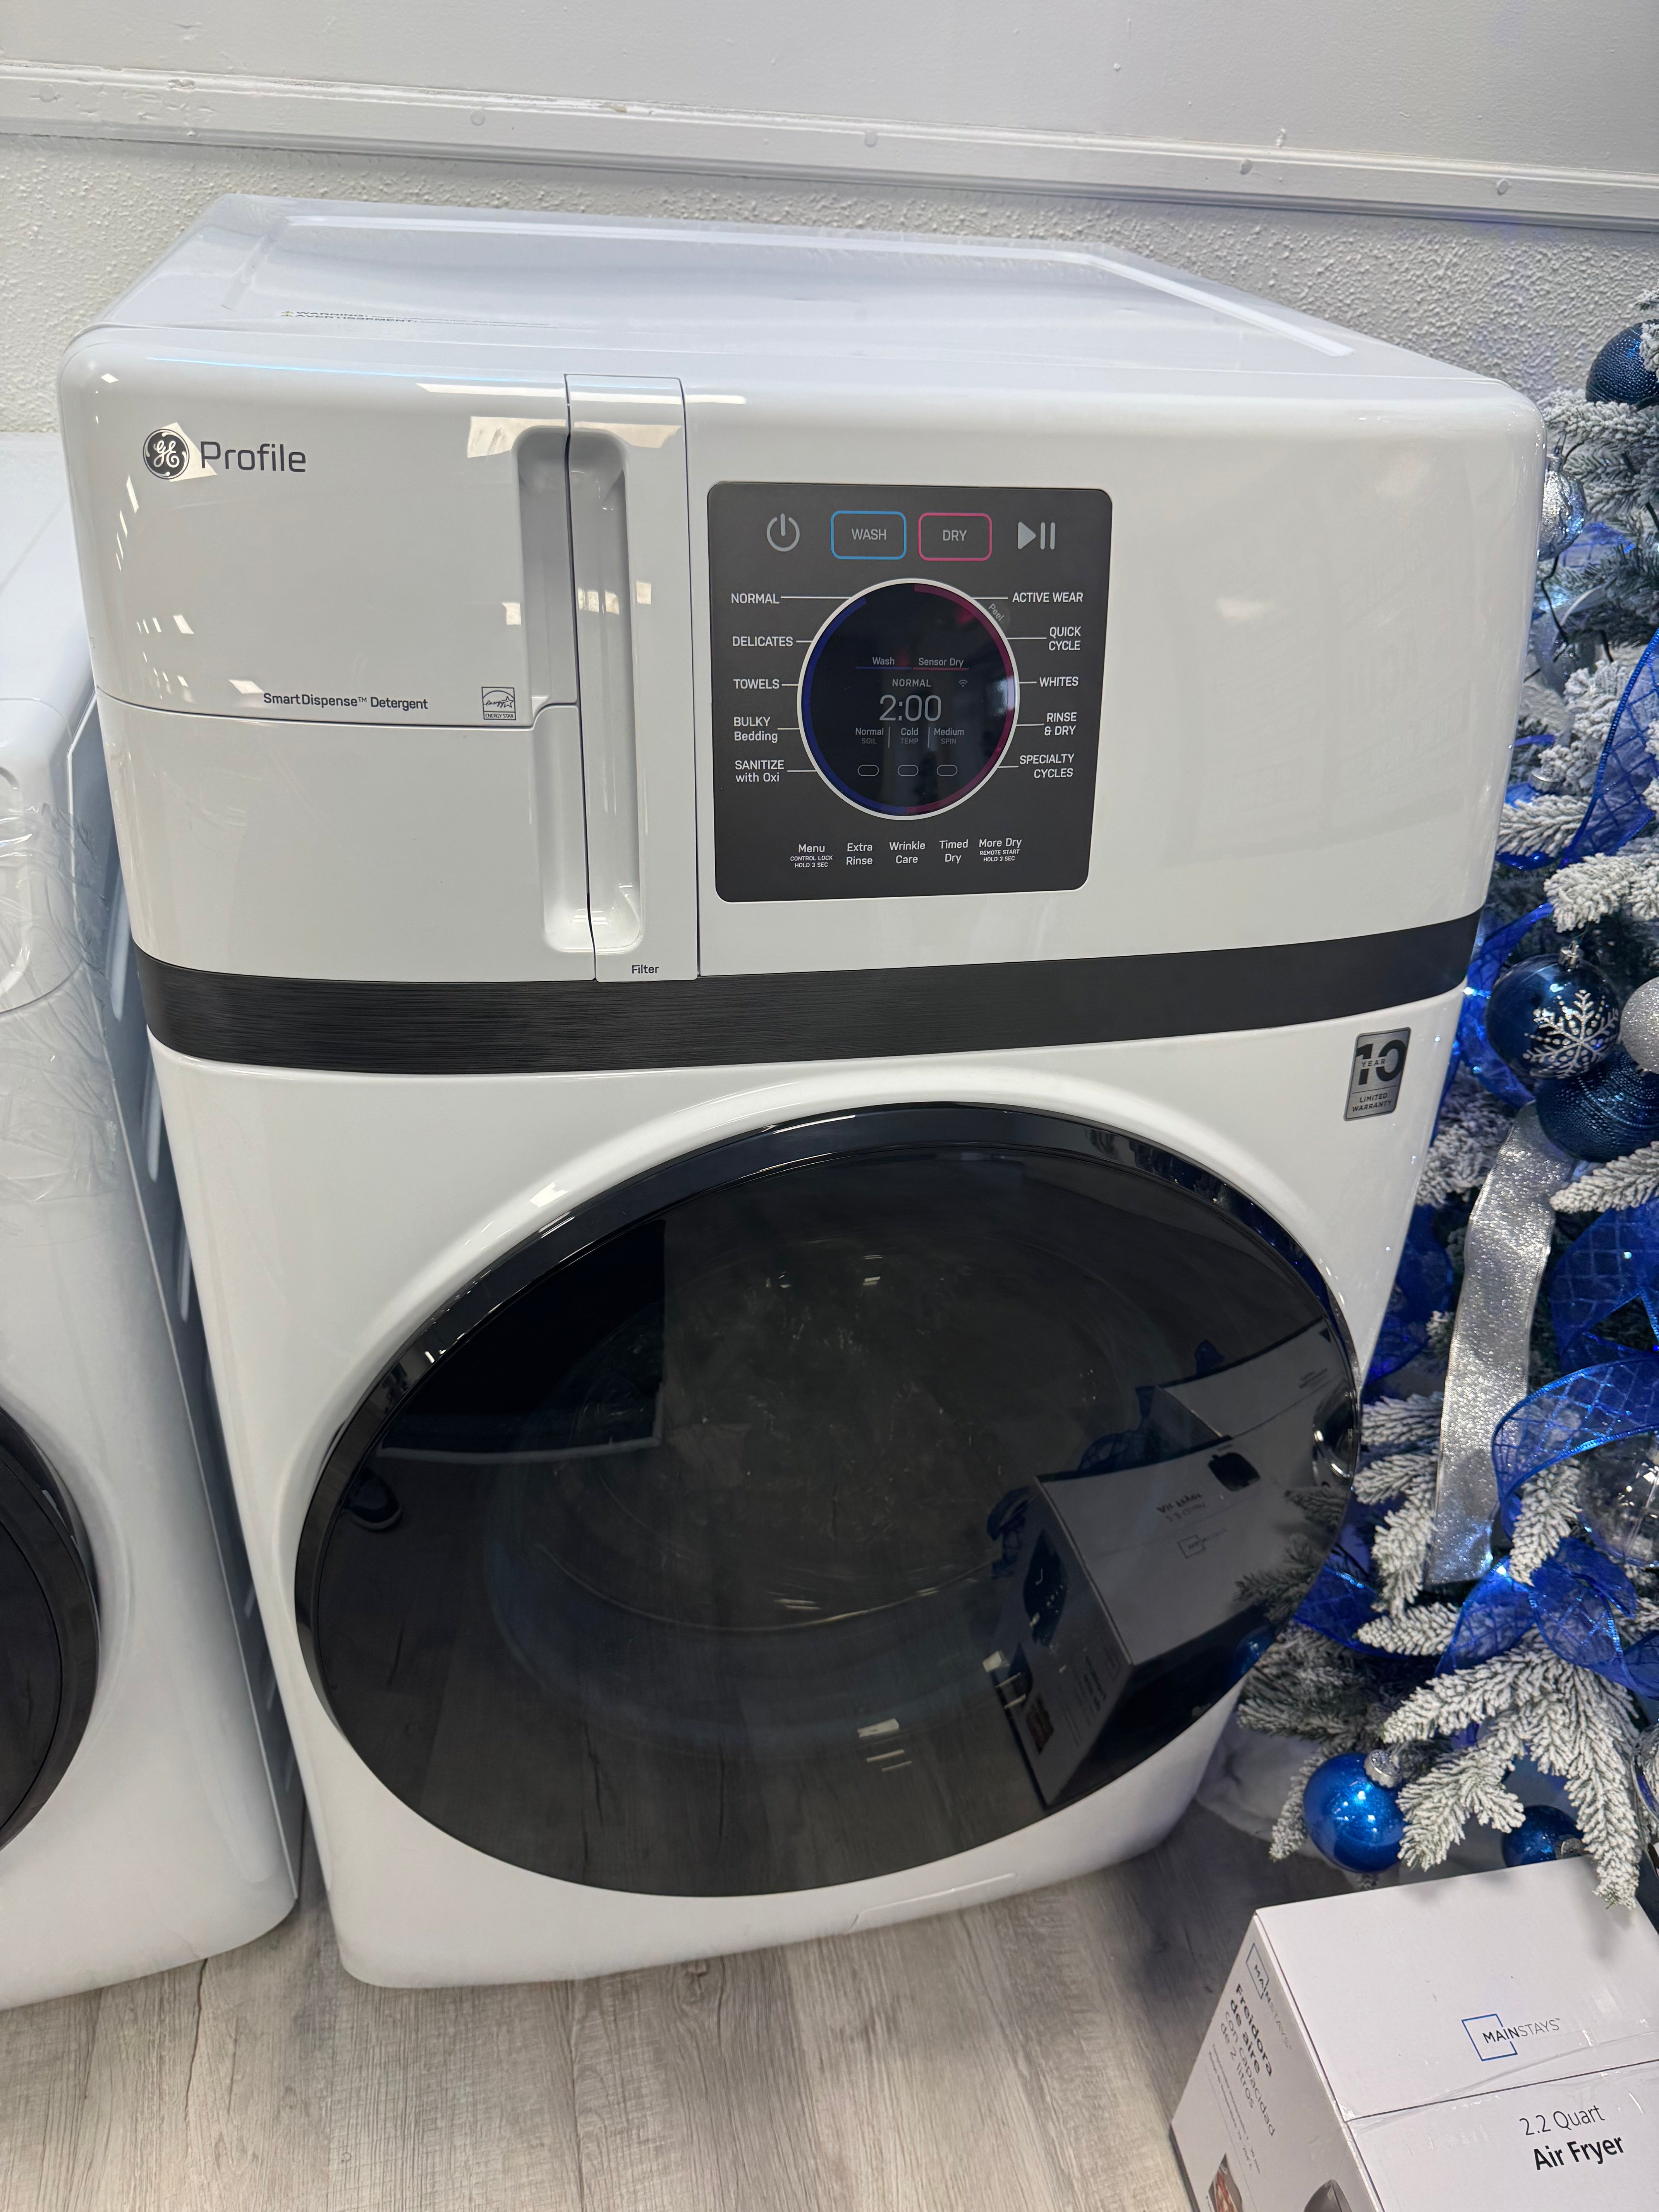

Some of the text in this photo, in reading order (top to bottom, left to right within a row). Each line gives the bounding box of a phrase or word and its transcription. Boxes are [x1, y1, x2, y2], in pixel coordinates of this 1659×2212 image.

[200, 441, 306, 472] Profile
[852, 528, 886, 540] WASH
[943, 530, 967, 541] DRY
[731, 593, 780, 604] NORMAL
[1012, 592, 1083, 603] ACTIVE WEAR
[988, 603, 1005, 622] Peel
[1049, 626, 1082, 638] QUICK
[732, 636, 793, 647] DELICATES
[1049, 640, 1081, 651] CYCLE
[872, 656, 895, 665] Wash
[919, 658, 964, 668] Sensor Dry
[733, 678, 780, 689] TOWELS
[892, 678, 931, 687] NORMAL
[1039, 676, 1079, 687] WHITES
[370, 697, 428, 711] Detergent
[879, 694, 941, 721] 2:00
[734, 716, 771, 726] BULKY
[1047, 712, 1077, 723] RINSE
[855, 727, 884, 735] Normal
[901, 727, 919, 736] Cold
[1044, 725, 1076, 736] & DRY
[734, 731, 778, 743] Bedding
[735, 760, 784, 770] SANITIZE
[1019, 754, 1075, 765] SPECIALTY
[735, 772, 779, 782] with Oxi
[1034, 768, 1073, 778] CYCLES
[798, 844, 825, 853] Menu
[847, 843, 872, 852] Extra
[889, 840, 926, 850] Wrinkle
[939, 839, 968, 849] Timed
[979, 838, 1022, 848] More Dry
[846, 856, 873, 865] Rinse
[896, 855, 918, 864] Care
[945, 854, 962, 864] Dry
[632, 965, 659, 974] Filter
[1355, 1039, 1407, 1085] 10
[1362, 1059, 1385, 1067] YEAR
[1360, 1093, 1387, 1103] LIMITED
[1352, 1100, 1391, 1111] WARRANTY
[1236, 1984, 1272, 2076] Freidora
[1242, 2032, 1260, 2074] aire
[1239, 2047, 1275, 2136] capacidad
[1519, 2104, 1605, 2136] 2.2 Quart
[1533, 2136, 1624, 2170] Air Fryer
